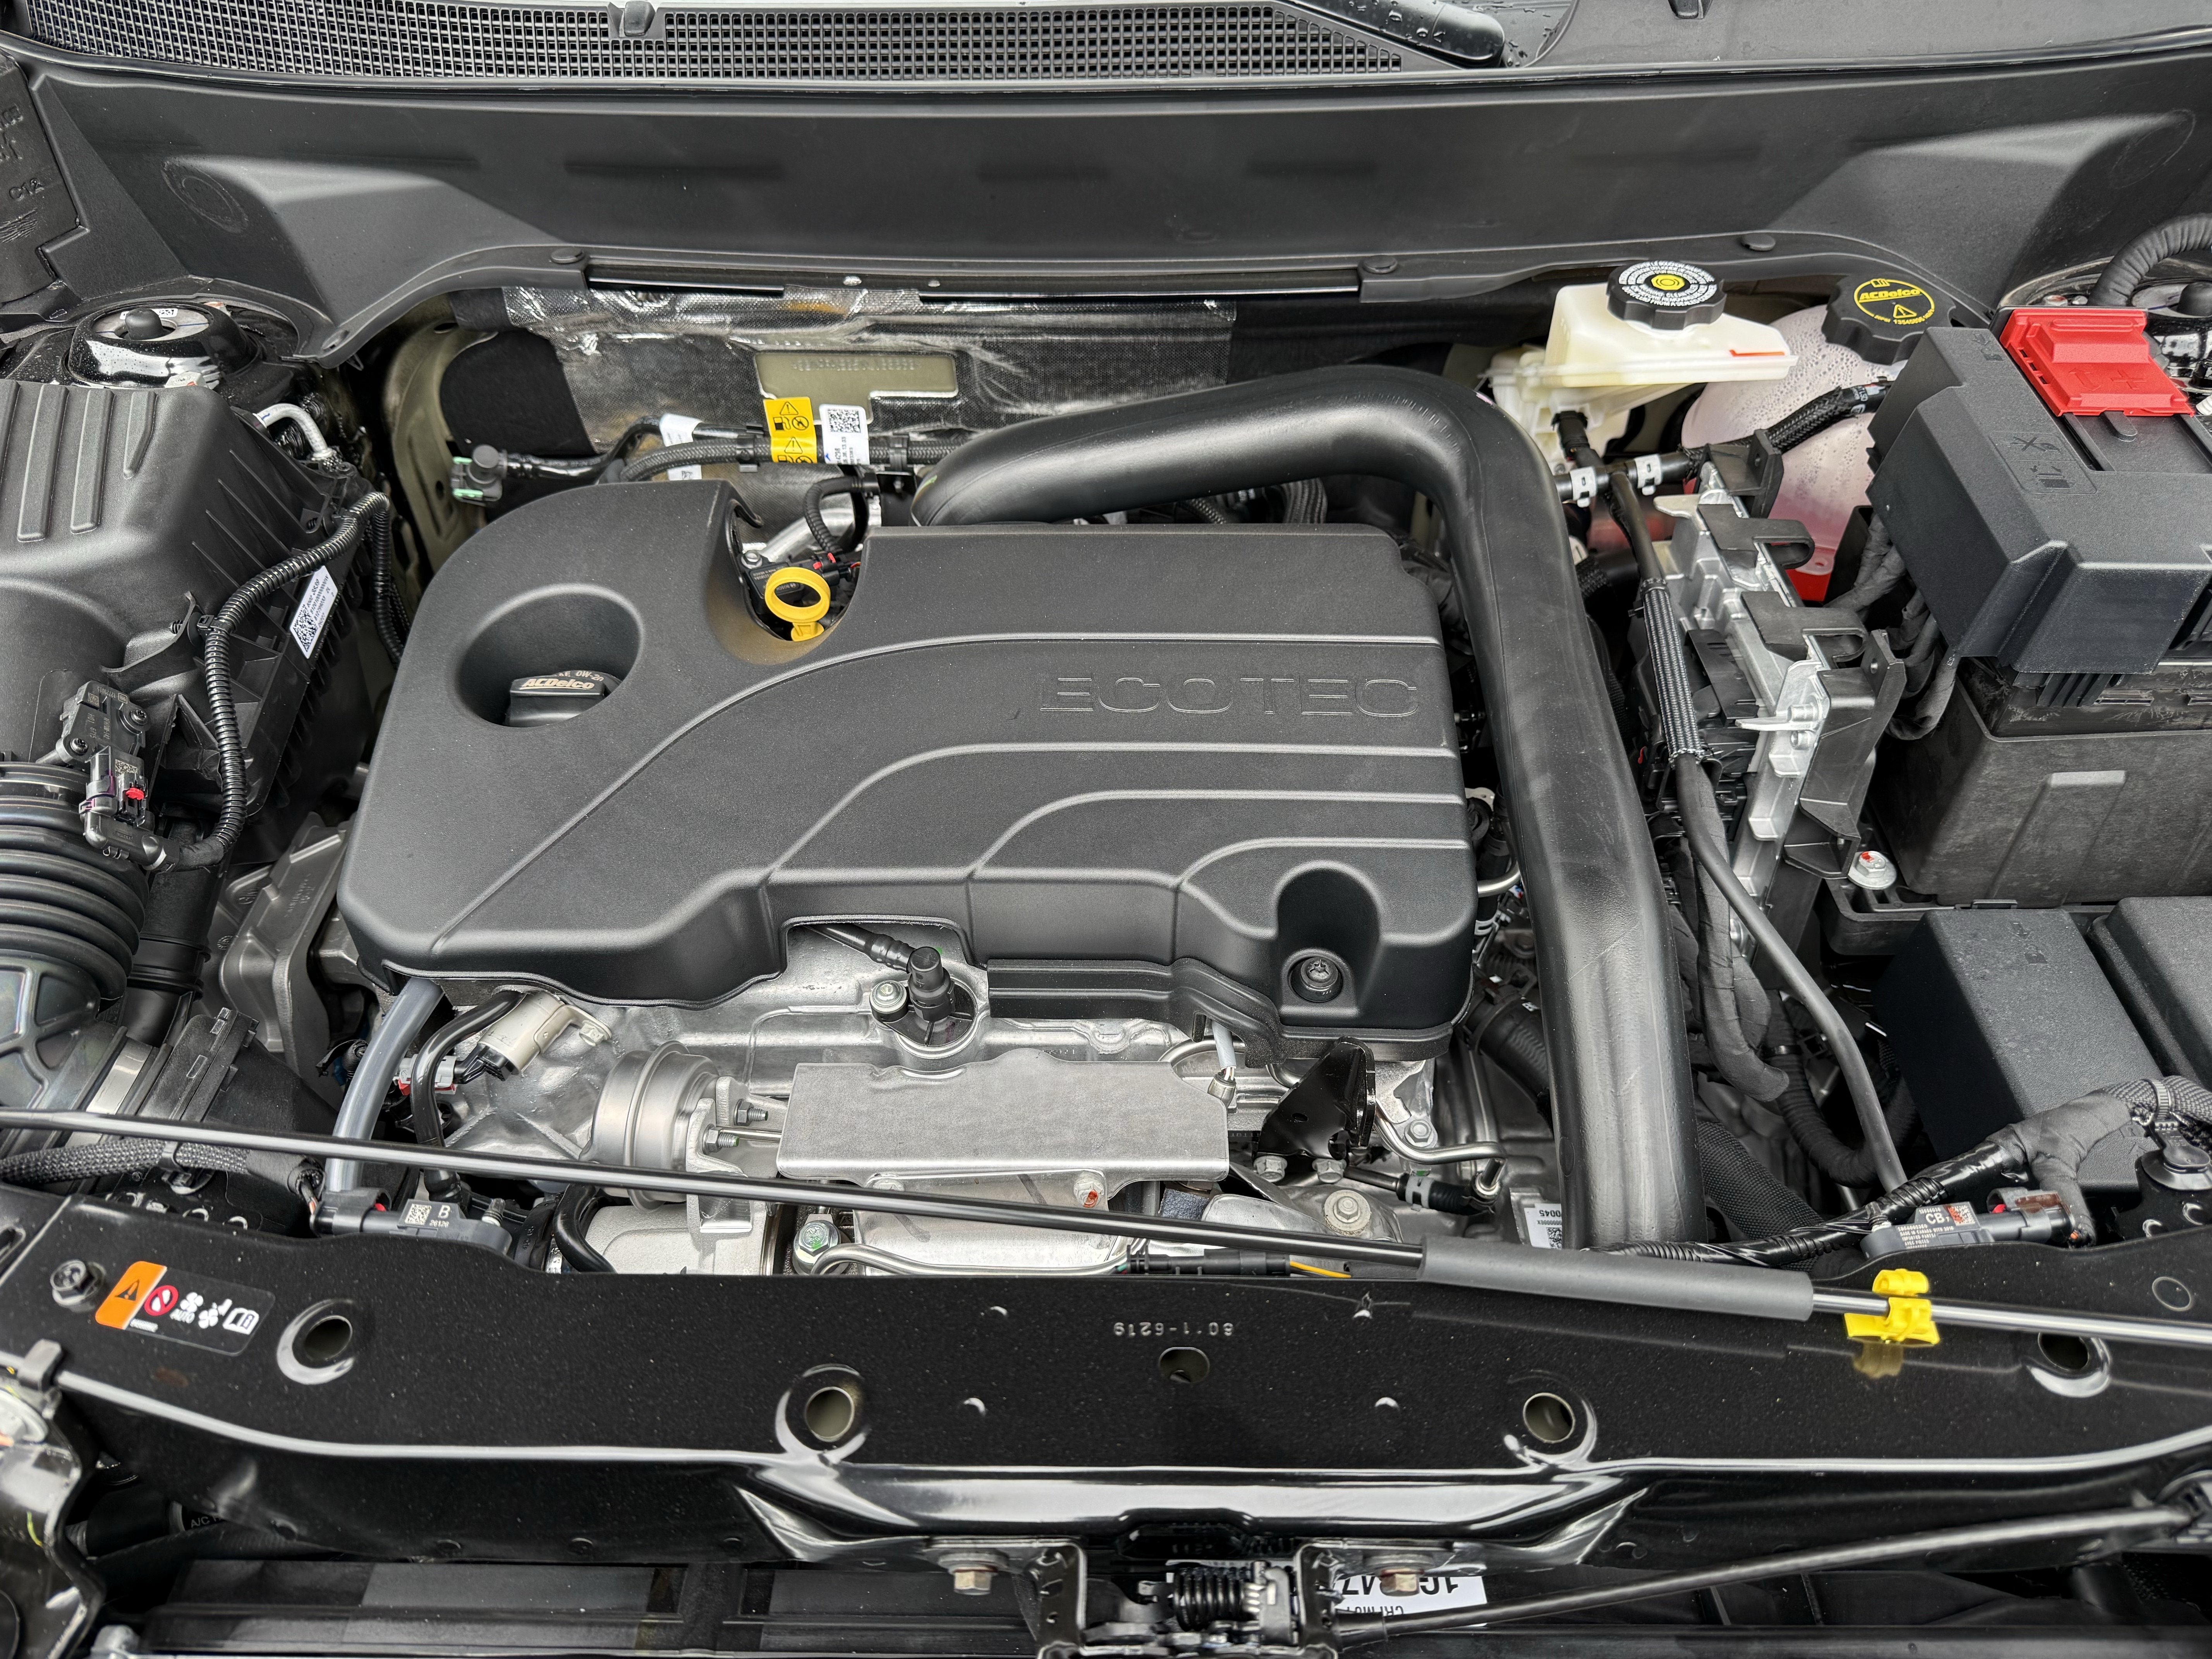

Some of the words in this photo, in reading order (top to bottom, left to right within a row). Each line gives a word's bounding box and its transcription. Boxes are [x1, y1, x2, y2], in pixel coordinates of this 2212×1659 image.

[521, 678, 595, 689] ACDelco
[1040, 675, 1419, 717] ECOTEC
[438, 1204, 451, 1219] B
[1925, 1212, 1945, 1224] CB
[170, 1308, 195, 1324] AUTO
